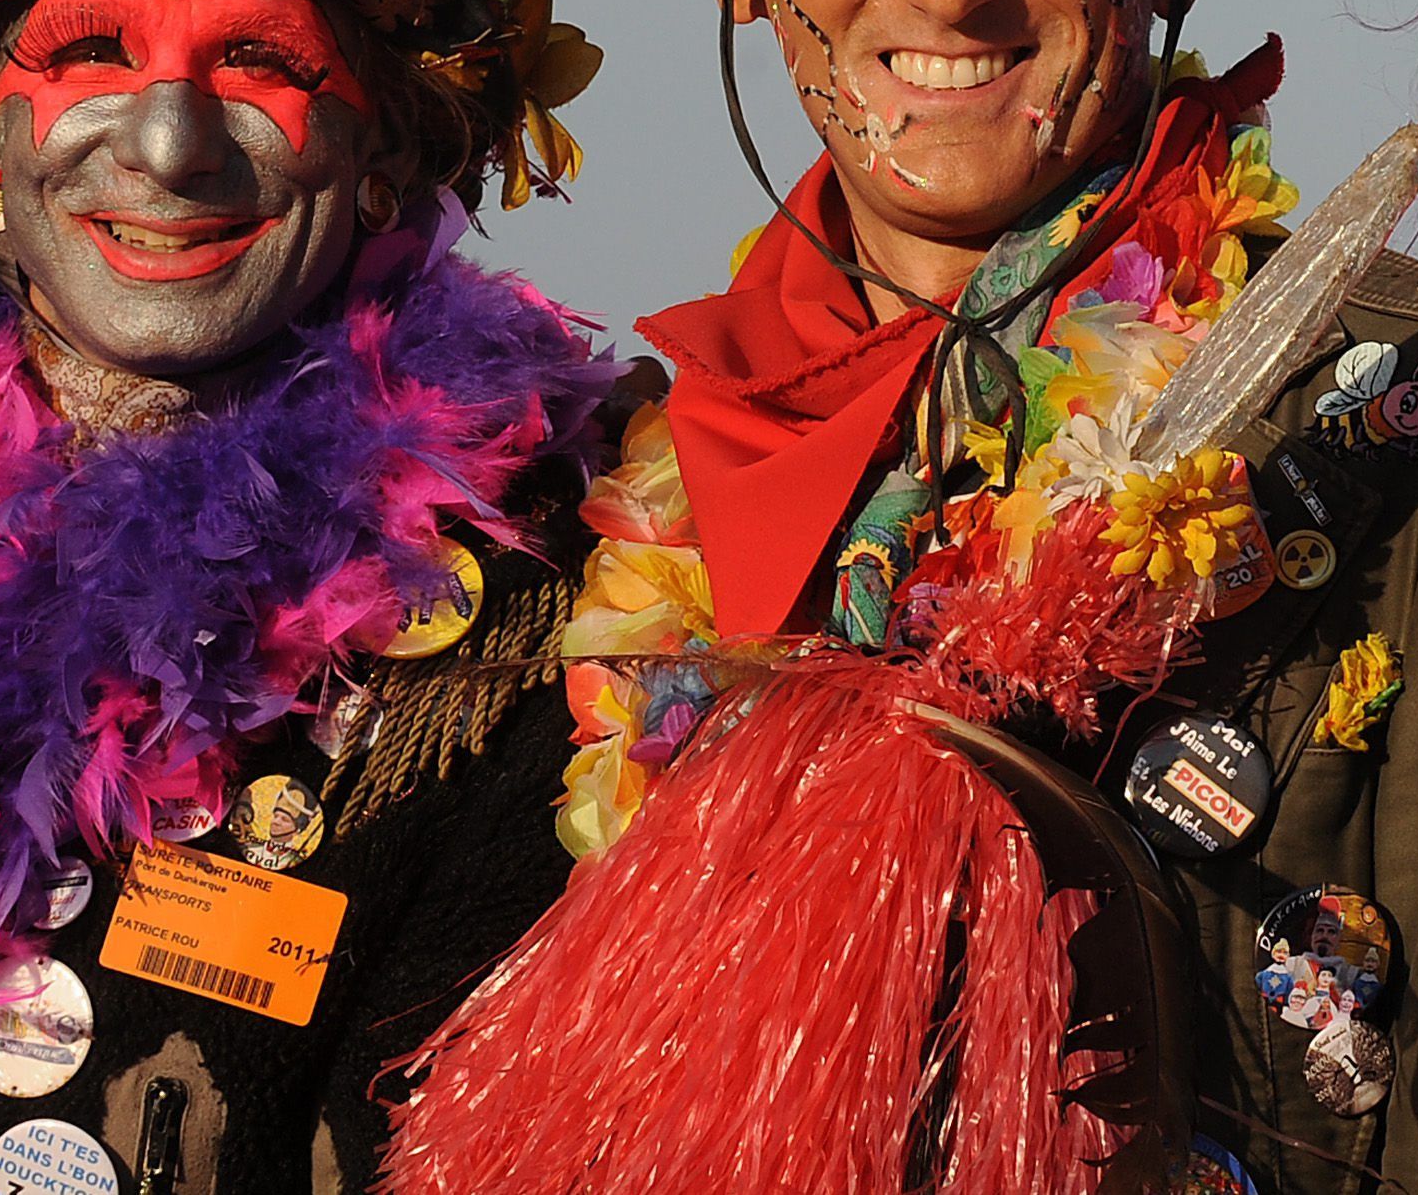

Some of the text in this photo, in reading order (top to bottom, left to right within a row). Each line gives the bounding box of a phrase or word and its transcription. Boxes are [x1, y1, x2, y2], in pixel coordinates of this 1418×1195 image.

[1170, 722, 1238, 779] J'Aime Le
[1211, 720, 1255, 757] Moi
[1131, 757, 1150, 781] Et
[1174, 766, 1245, 826] PICON
[1142, 784, 1170, 814] Les
[1168, 804, 1219, 852] Nichons
[135, 859, 228, 893] Port de Dunkerque
[115, 916, 199, 949] PATRICE ROU
[267, 936, 316, 964] 2011
[28, 1125, 101, 1164] ICI T'ES
[3, 1137, 52, 1167] DANS
[58, 1160, 115, 1192] L'BON
